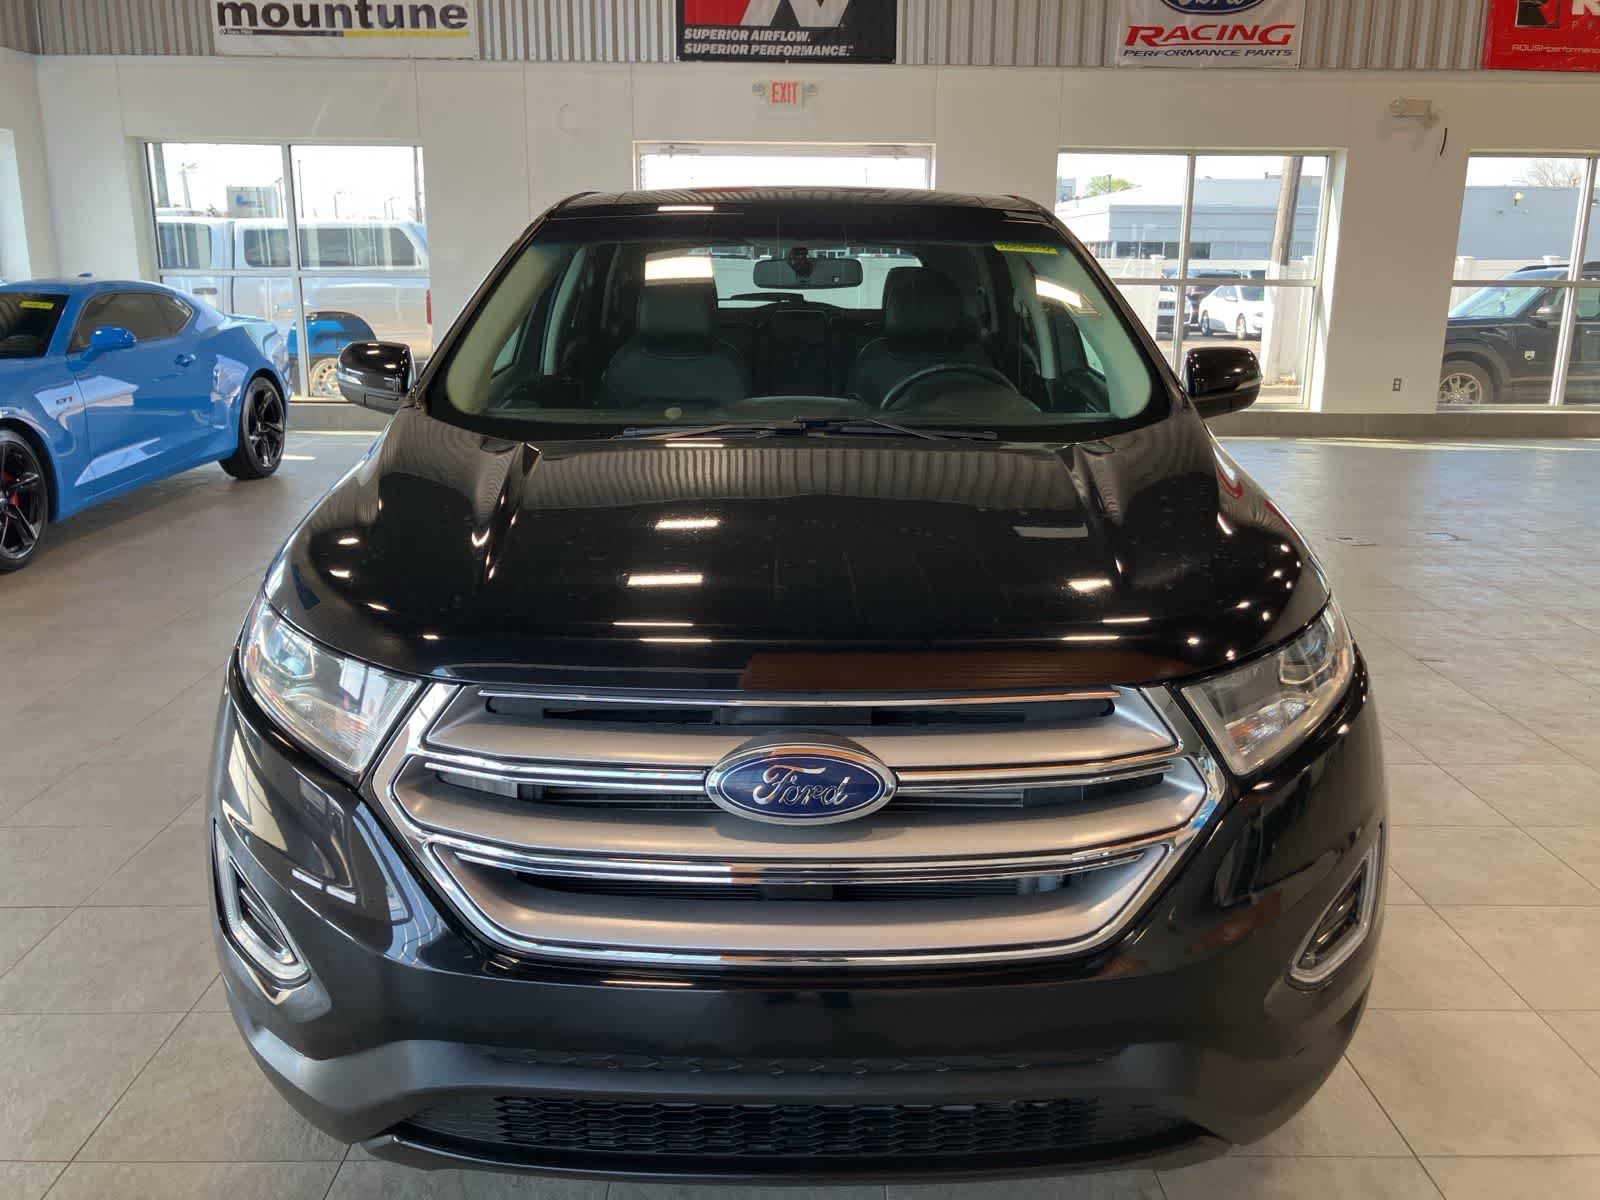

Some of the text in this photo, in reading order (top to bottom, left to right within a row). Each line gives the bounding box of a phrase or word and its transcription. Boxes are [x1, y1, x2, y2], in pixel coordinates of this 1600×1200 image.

[217, 0, 469, 29] mountune
[684, 28, 811, 42] SUPERIOR AIRFLOW.
[1125, 25, 1295, 47] RACING
[684, 43, 749, 56] SUPERIOR
[1123, 49, 1293, 57] PERFORMANCE PARTS
[771, 81, 799, 104] EXIT
[753, 764, 852, 806] Ford
